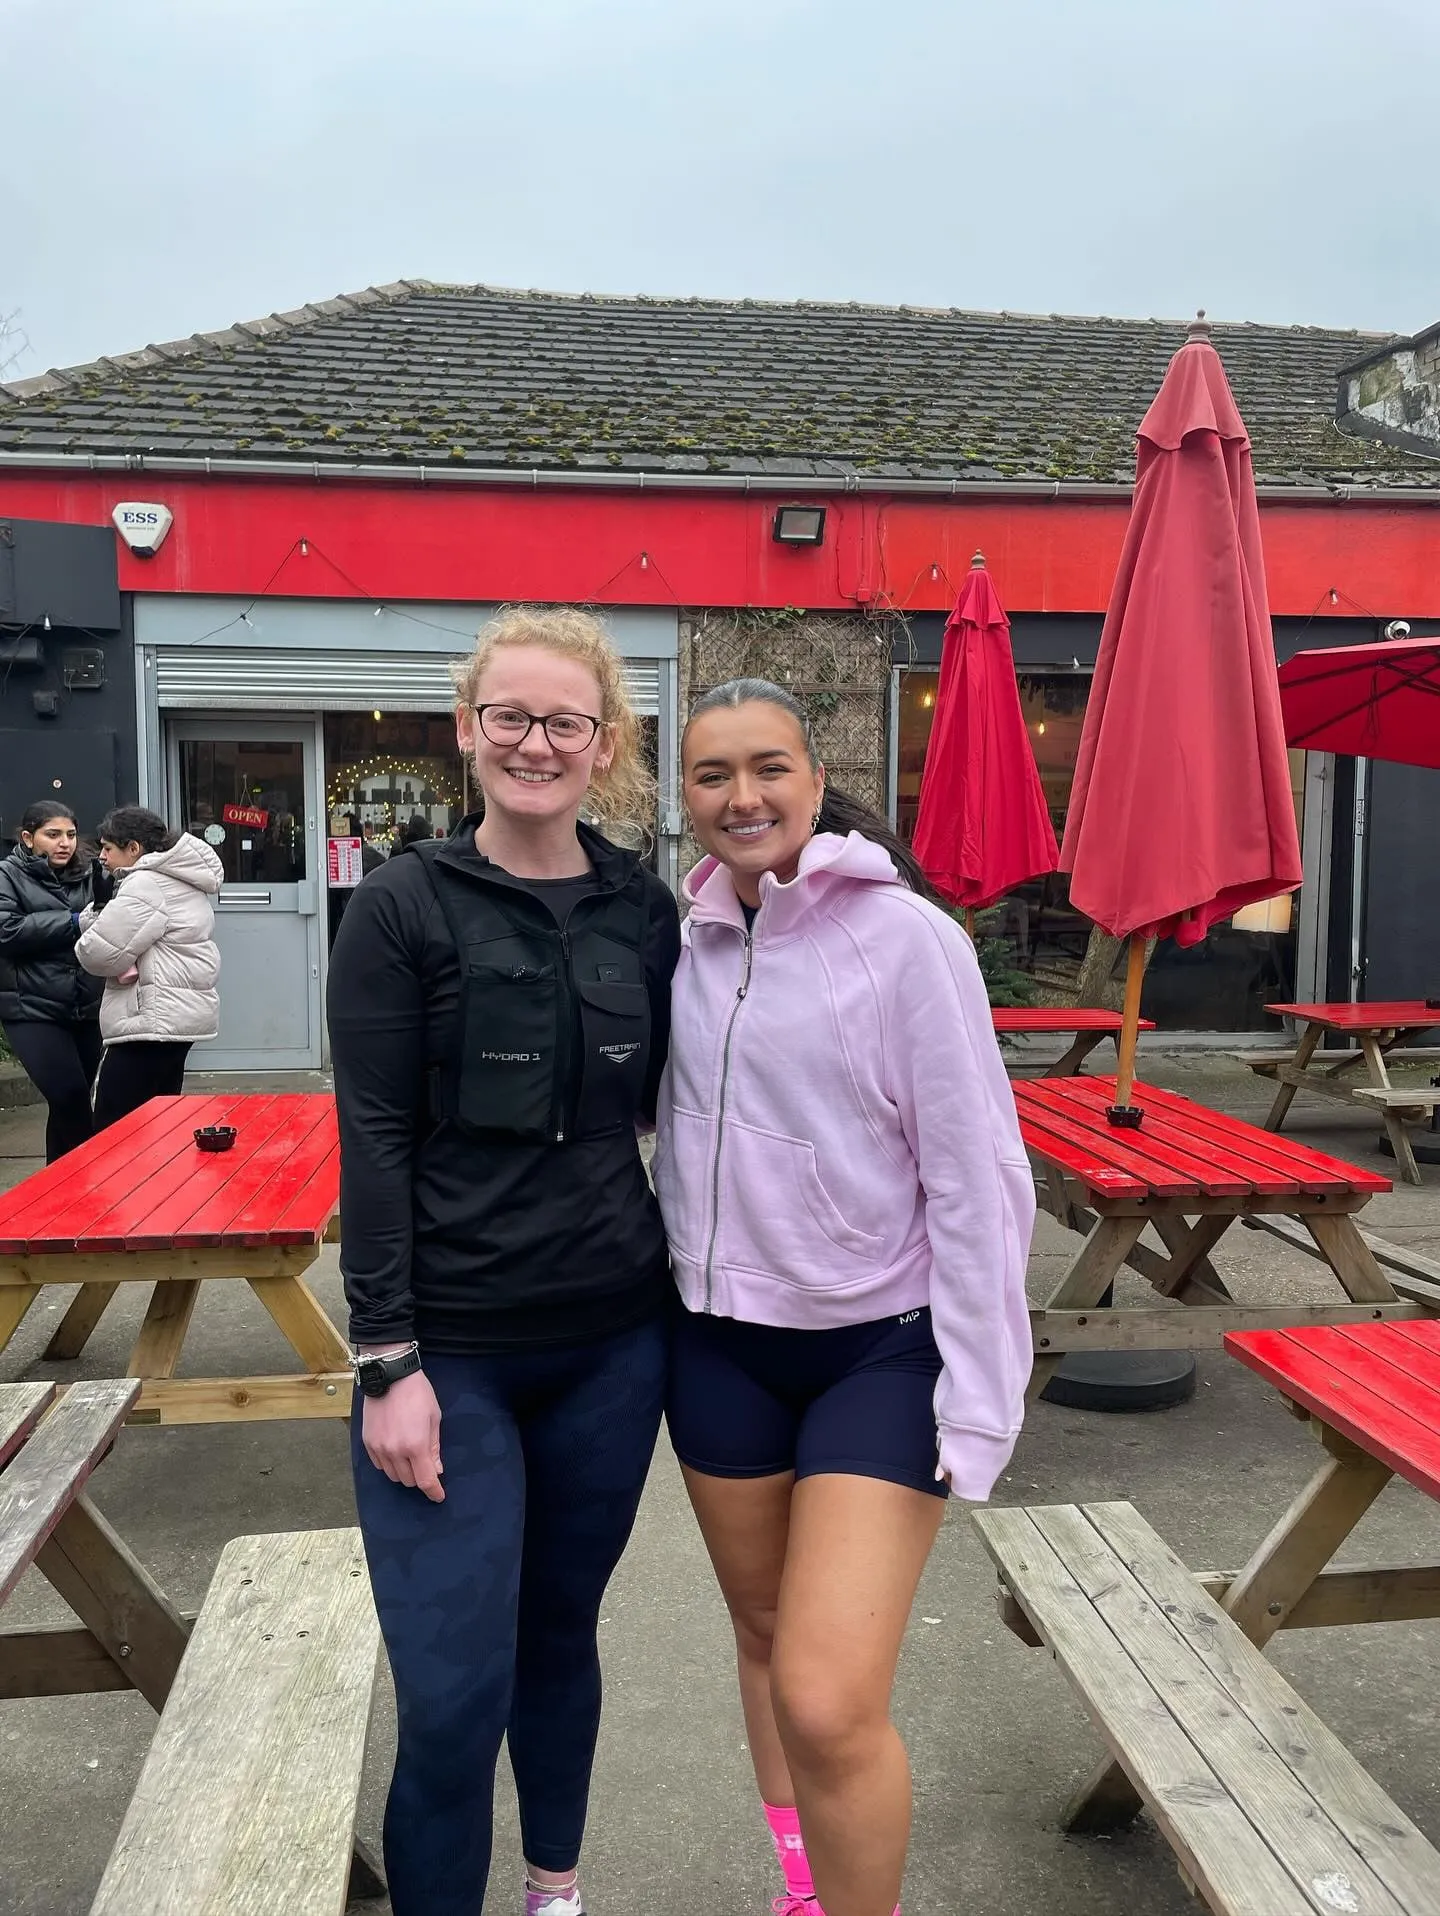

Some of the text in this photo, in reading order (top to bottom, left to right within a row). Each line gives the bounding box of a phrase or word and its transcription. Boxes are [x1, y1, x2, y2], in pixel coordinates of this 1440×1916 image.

[123, 512, 158, 523] ESS
[228, 808, 263, 824] OPEN
[532, 1053, 541, 1061] 1
[899, 1311, 920, 1325] MP
